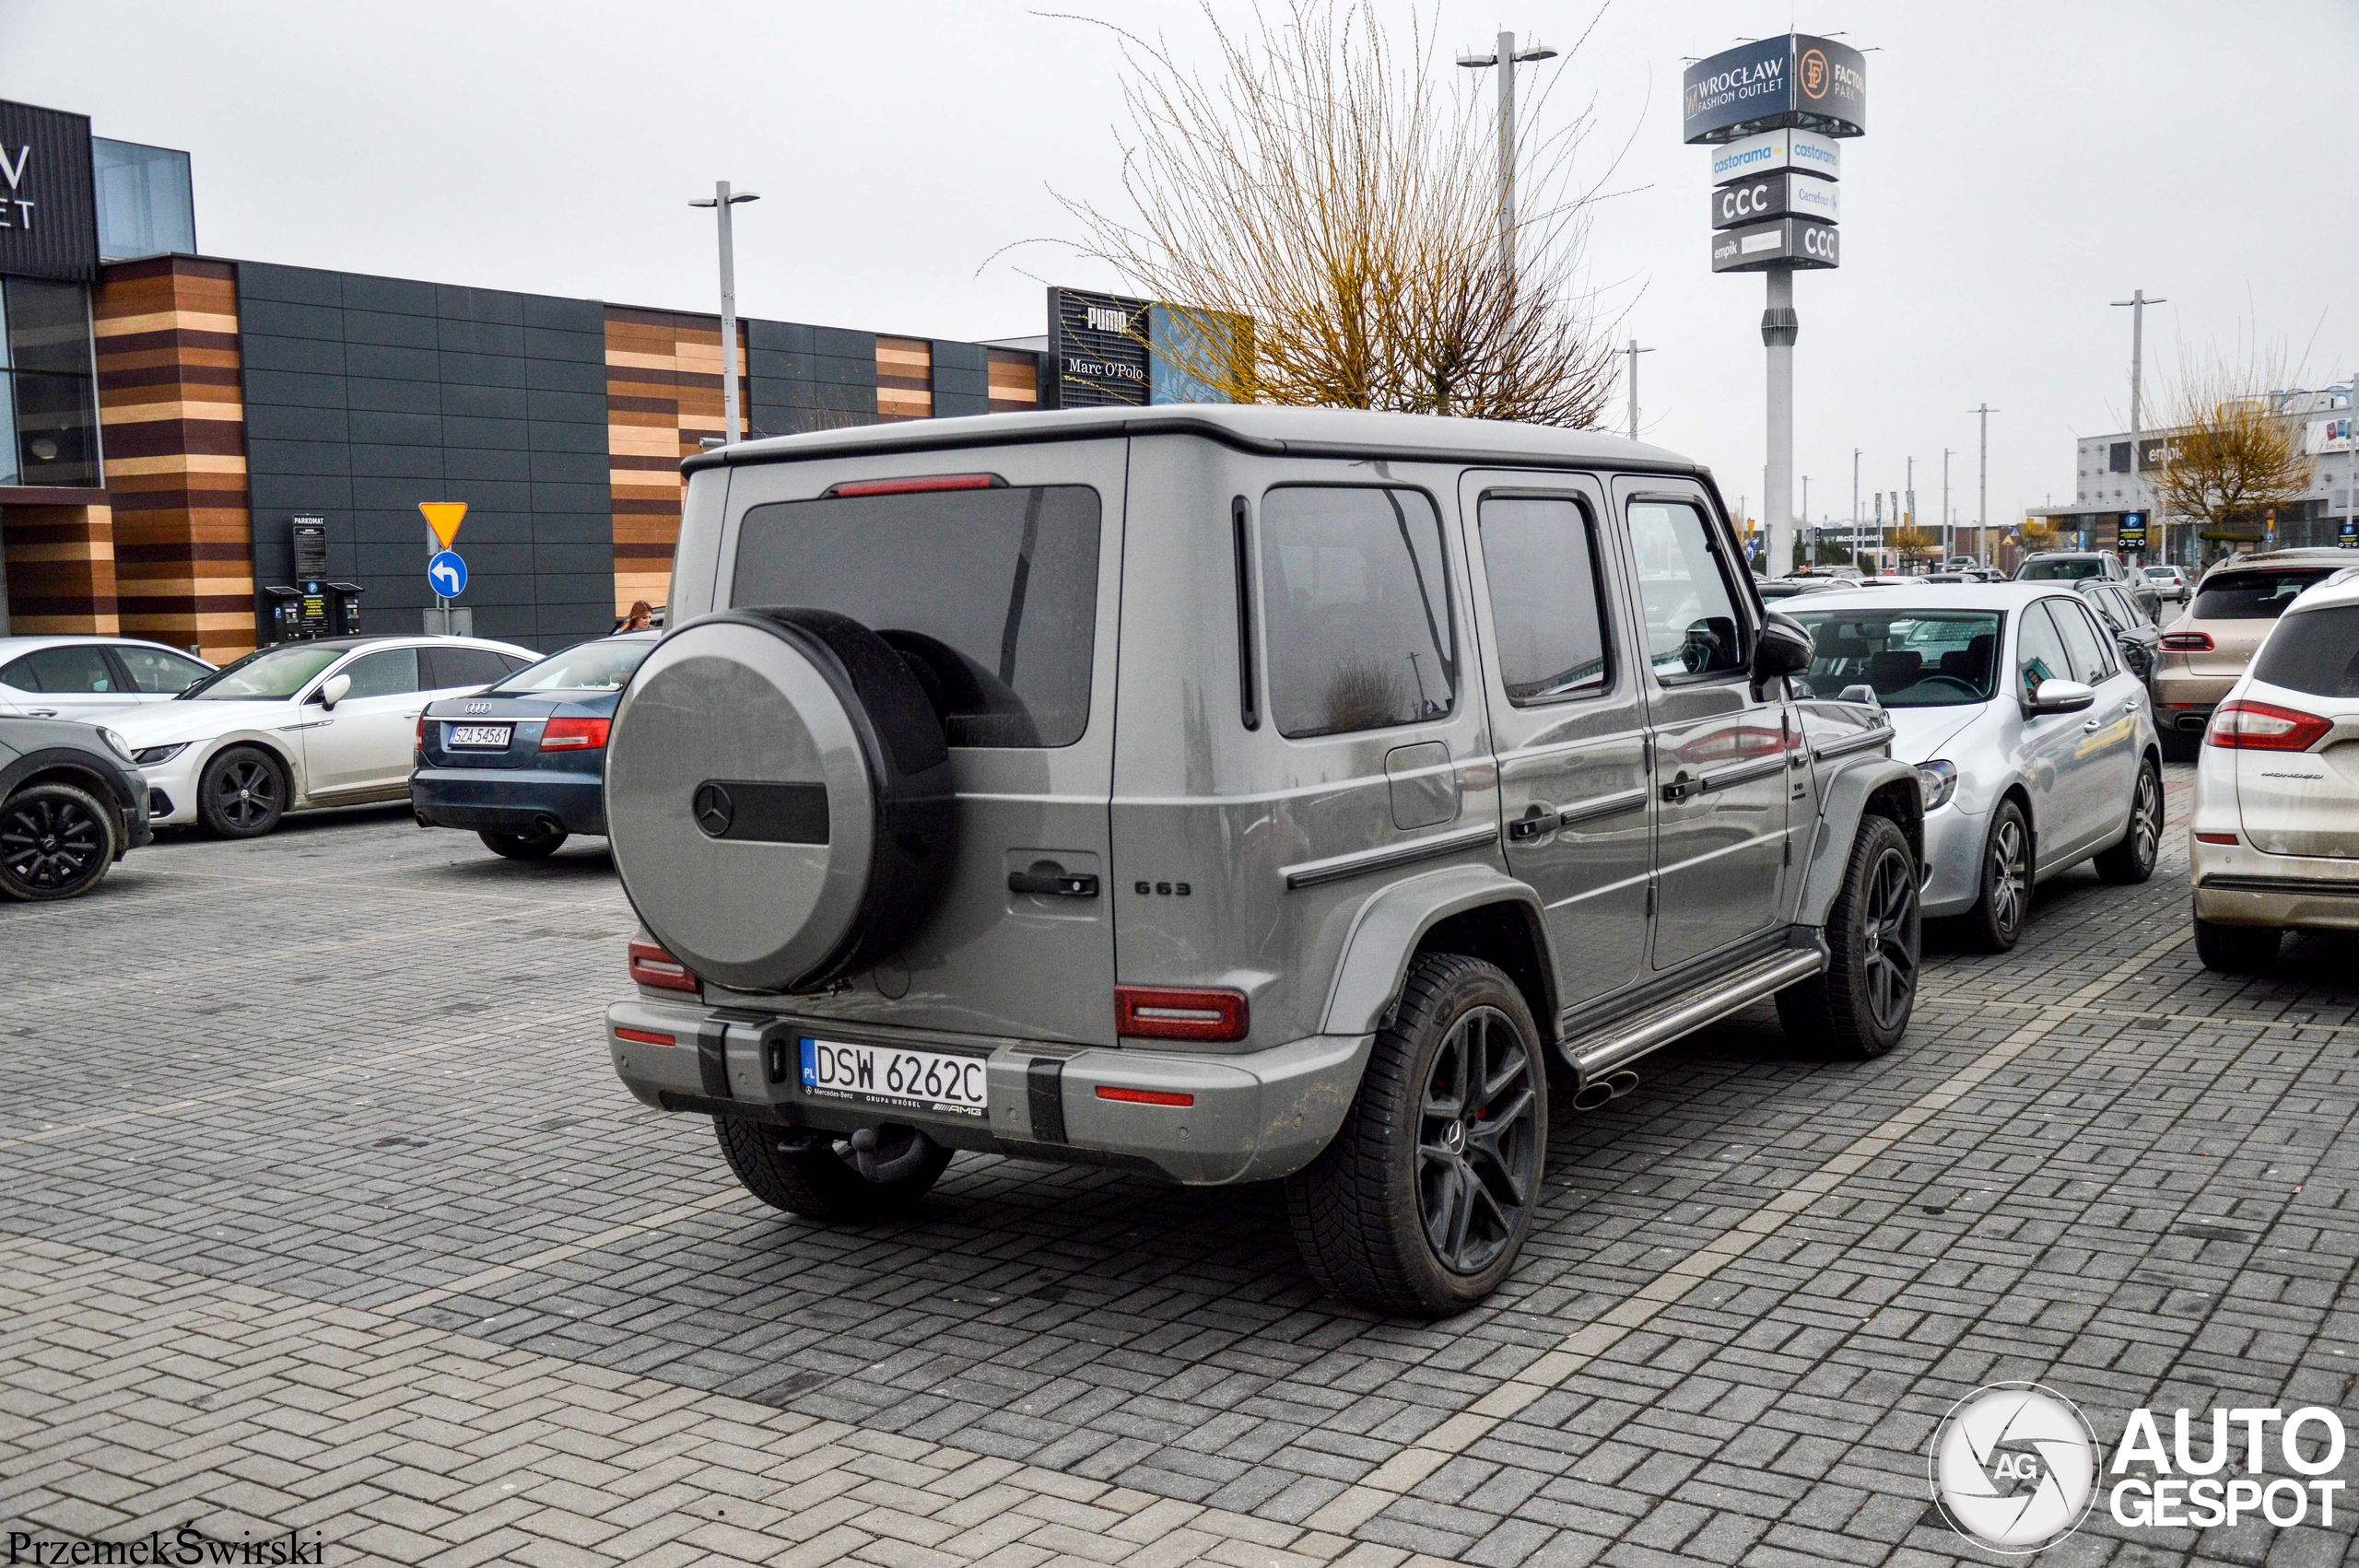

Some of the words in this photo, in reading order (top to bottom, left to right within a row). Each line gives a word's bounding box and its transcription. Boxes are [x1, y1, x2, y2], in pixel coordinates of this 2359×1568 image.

[1698, 57, 1783, 99] WROCŁAW
[1697, 90, 1734, 113] FASHION
[1738, 77, 1784, 99] OUTLET
[1835, 83, 1856, 101] PARK
[1714, 146, 1771, 174] castorama
[1795, 142, 1837, 167] castorama
[1722, 184, 1768, 219] CCC
[1799, 188, 1829, 207] Carrefour
[1714, 240, 1738, 260] empik
[1804, 227, 1835, 259] CCC
[1087, 307, 1126, 333] PUMA
[1069, 357, 1102, 376] Marc
[1105, 363, 1144, 380] O'Polo
[454, 728, 473, 743] SZA
[477, 728, 508, 744] 54561
[1134, 881, 1150, 895] G
[1156, 882, 1191, 896] 63
[804, 1068, 815, 1079] PL
[816, 1045, 874, 1090] DSW
[886, 1054, 983, 1103] 6262C
[814, 1088, 853, 1100] Mercedes-Benz
[866, 1095, 889, 1104] GRUPA
[892, 1098, 921, 1108] WRÓBEL
[949, 1106, 982, 1117] AMG
